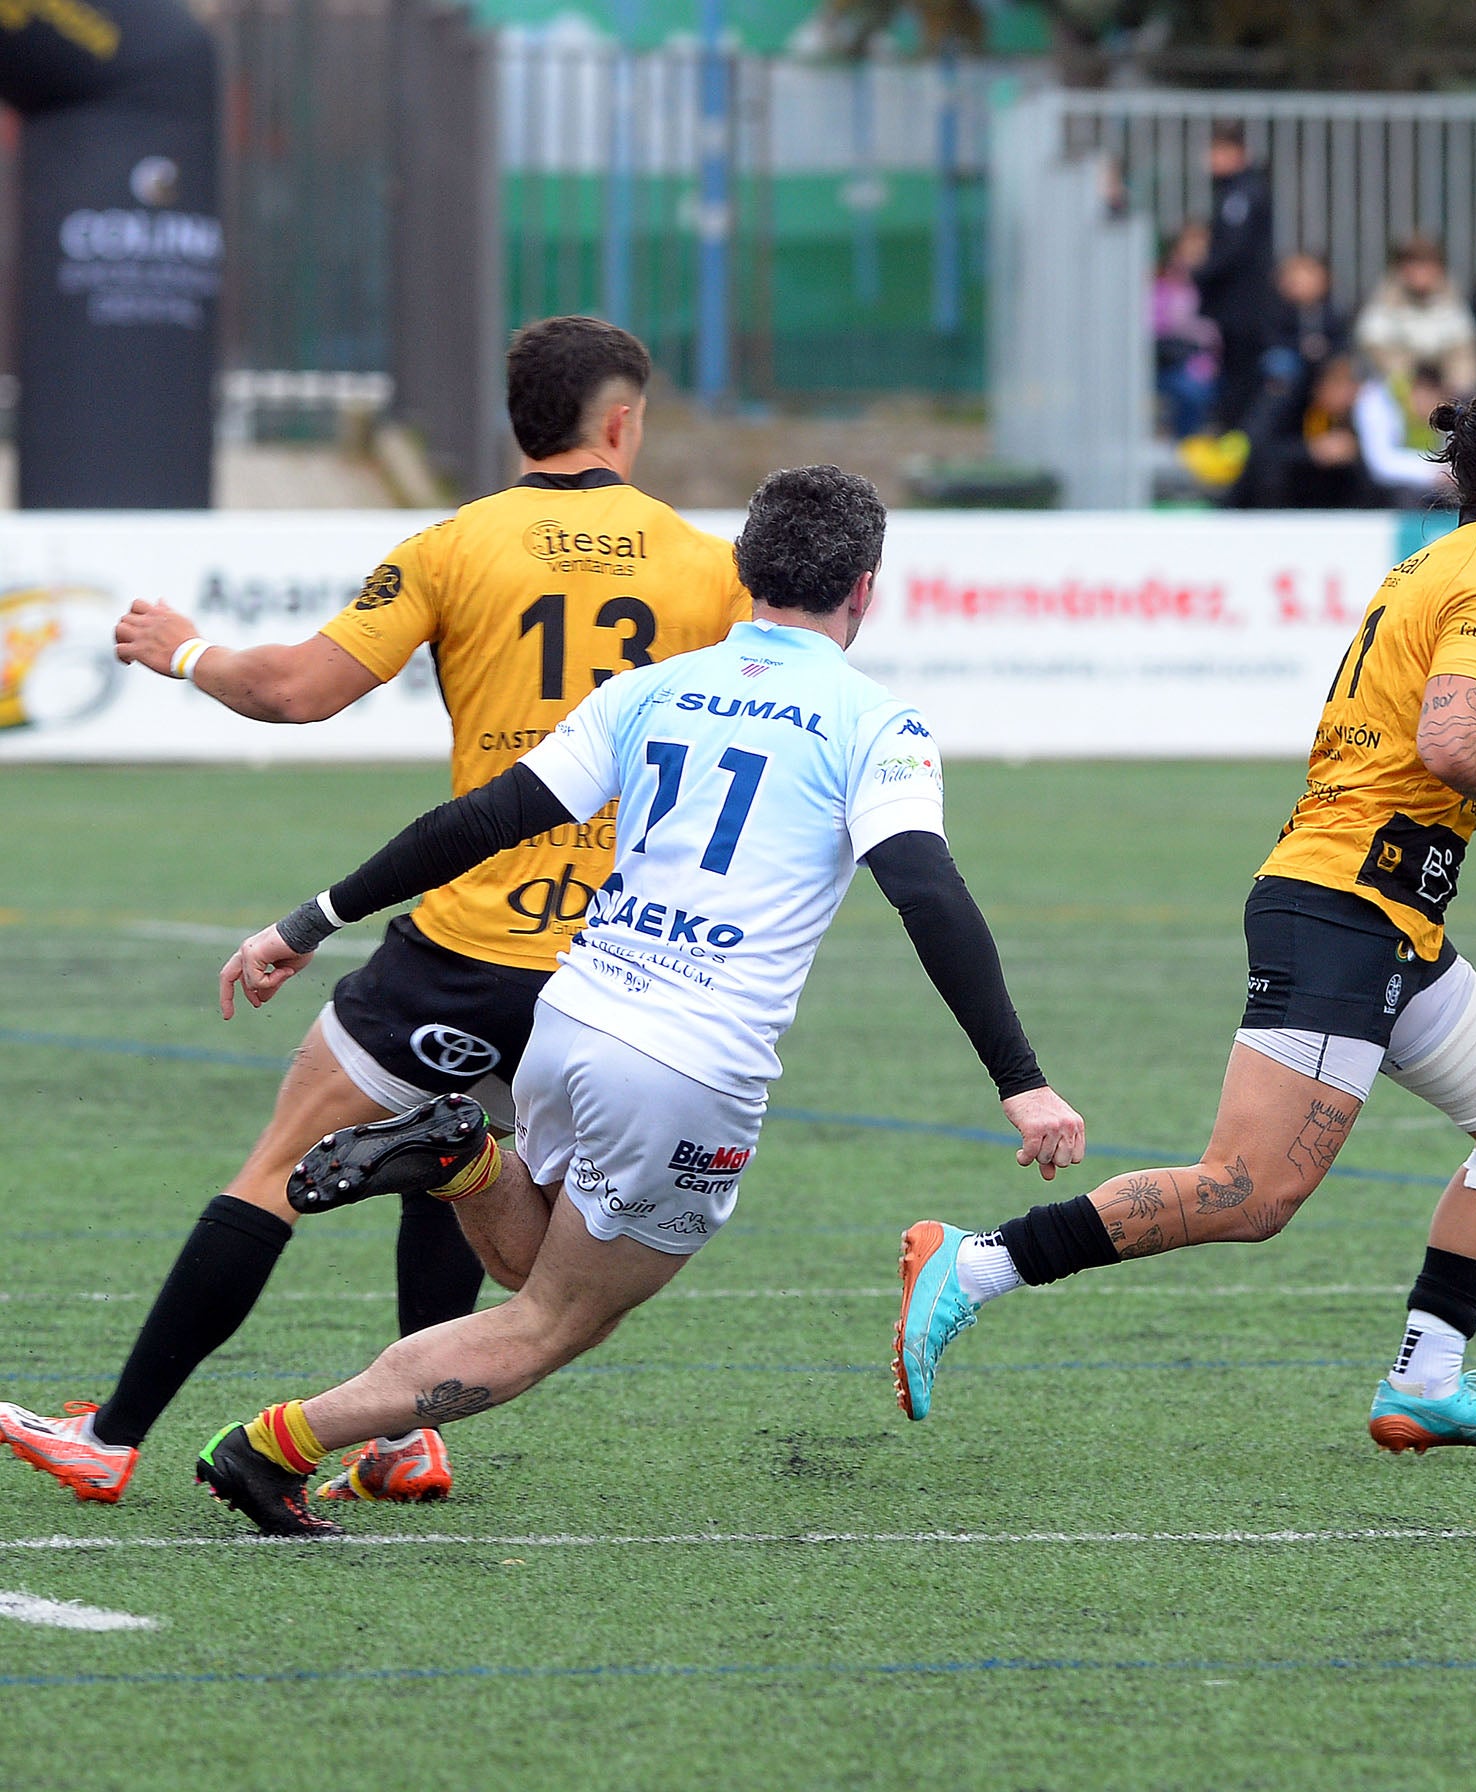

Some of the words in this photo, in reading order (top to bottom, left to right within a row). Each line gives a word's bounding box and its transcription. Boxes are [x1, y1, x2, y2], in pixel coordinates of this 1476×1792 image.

[545, 530, 648, 559] itesal
[549, 559, 637, 577] ventanas
[519, 594, 657, 701] 13
[676, 692, 828, 741] SUMAL
[632, 740, 769, 876] 11
[589, 874, 745, 949] NAEKO
[668, 1139, 750, 1174] BigMat
